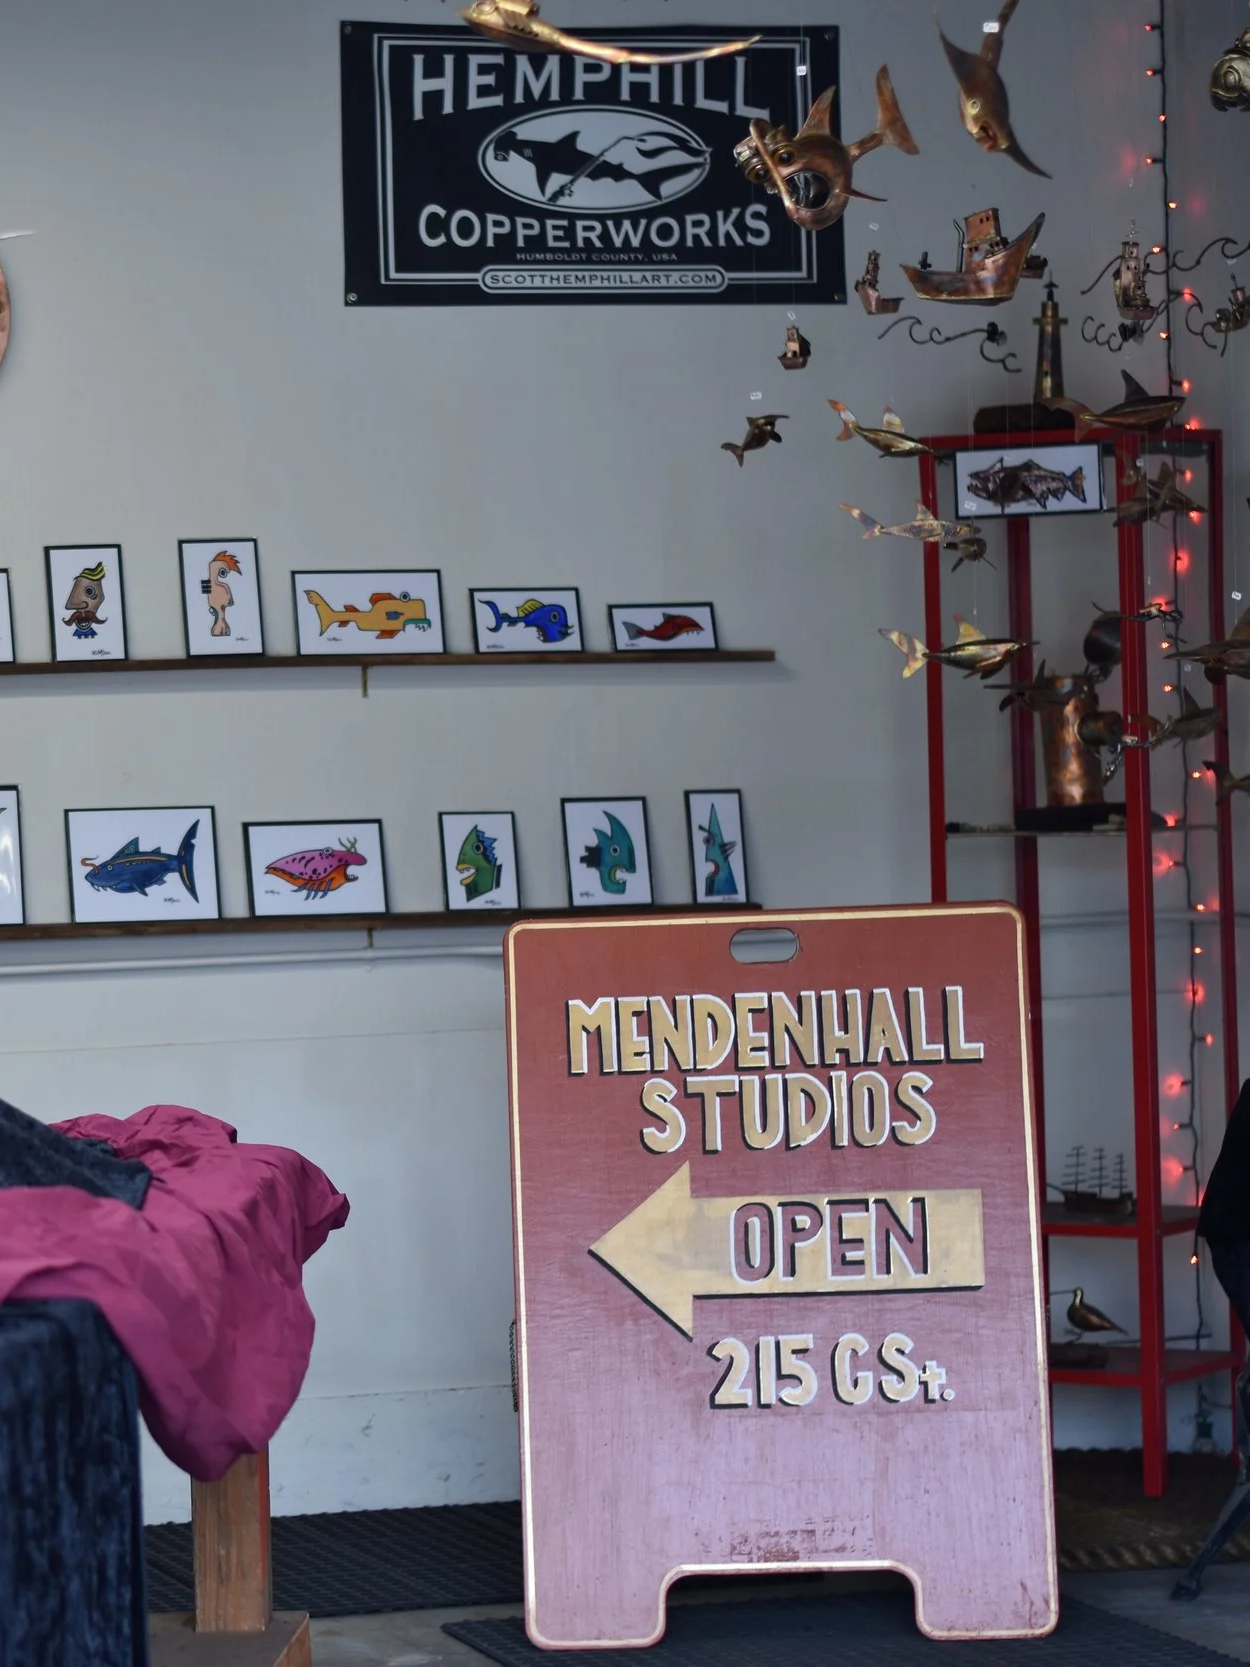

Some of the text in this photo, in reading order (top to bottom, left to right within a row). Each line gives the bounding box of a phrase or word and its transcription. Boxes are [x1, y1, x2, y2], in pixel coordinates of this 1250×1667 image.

[411, 53, 771, 121] HEMPHILL
[418, 203, 771, 249] COPPERWORKS
[516, 253, 678, 262] HUMBOLDT COUNTY, USA
[490, 273, 718, 286] SCOTTHEMPHILLART.COM
[566, 985, 985, 1076] MENDENHALL
[640, 1070, 937, 1154] STUDIOS
[728, 1196, 931, 1284] OPEN
[707, 1333, 818, 1409] 215
